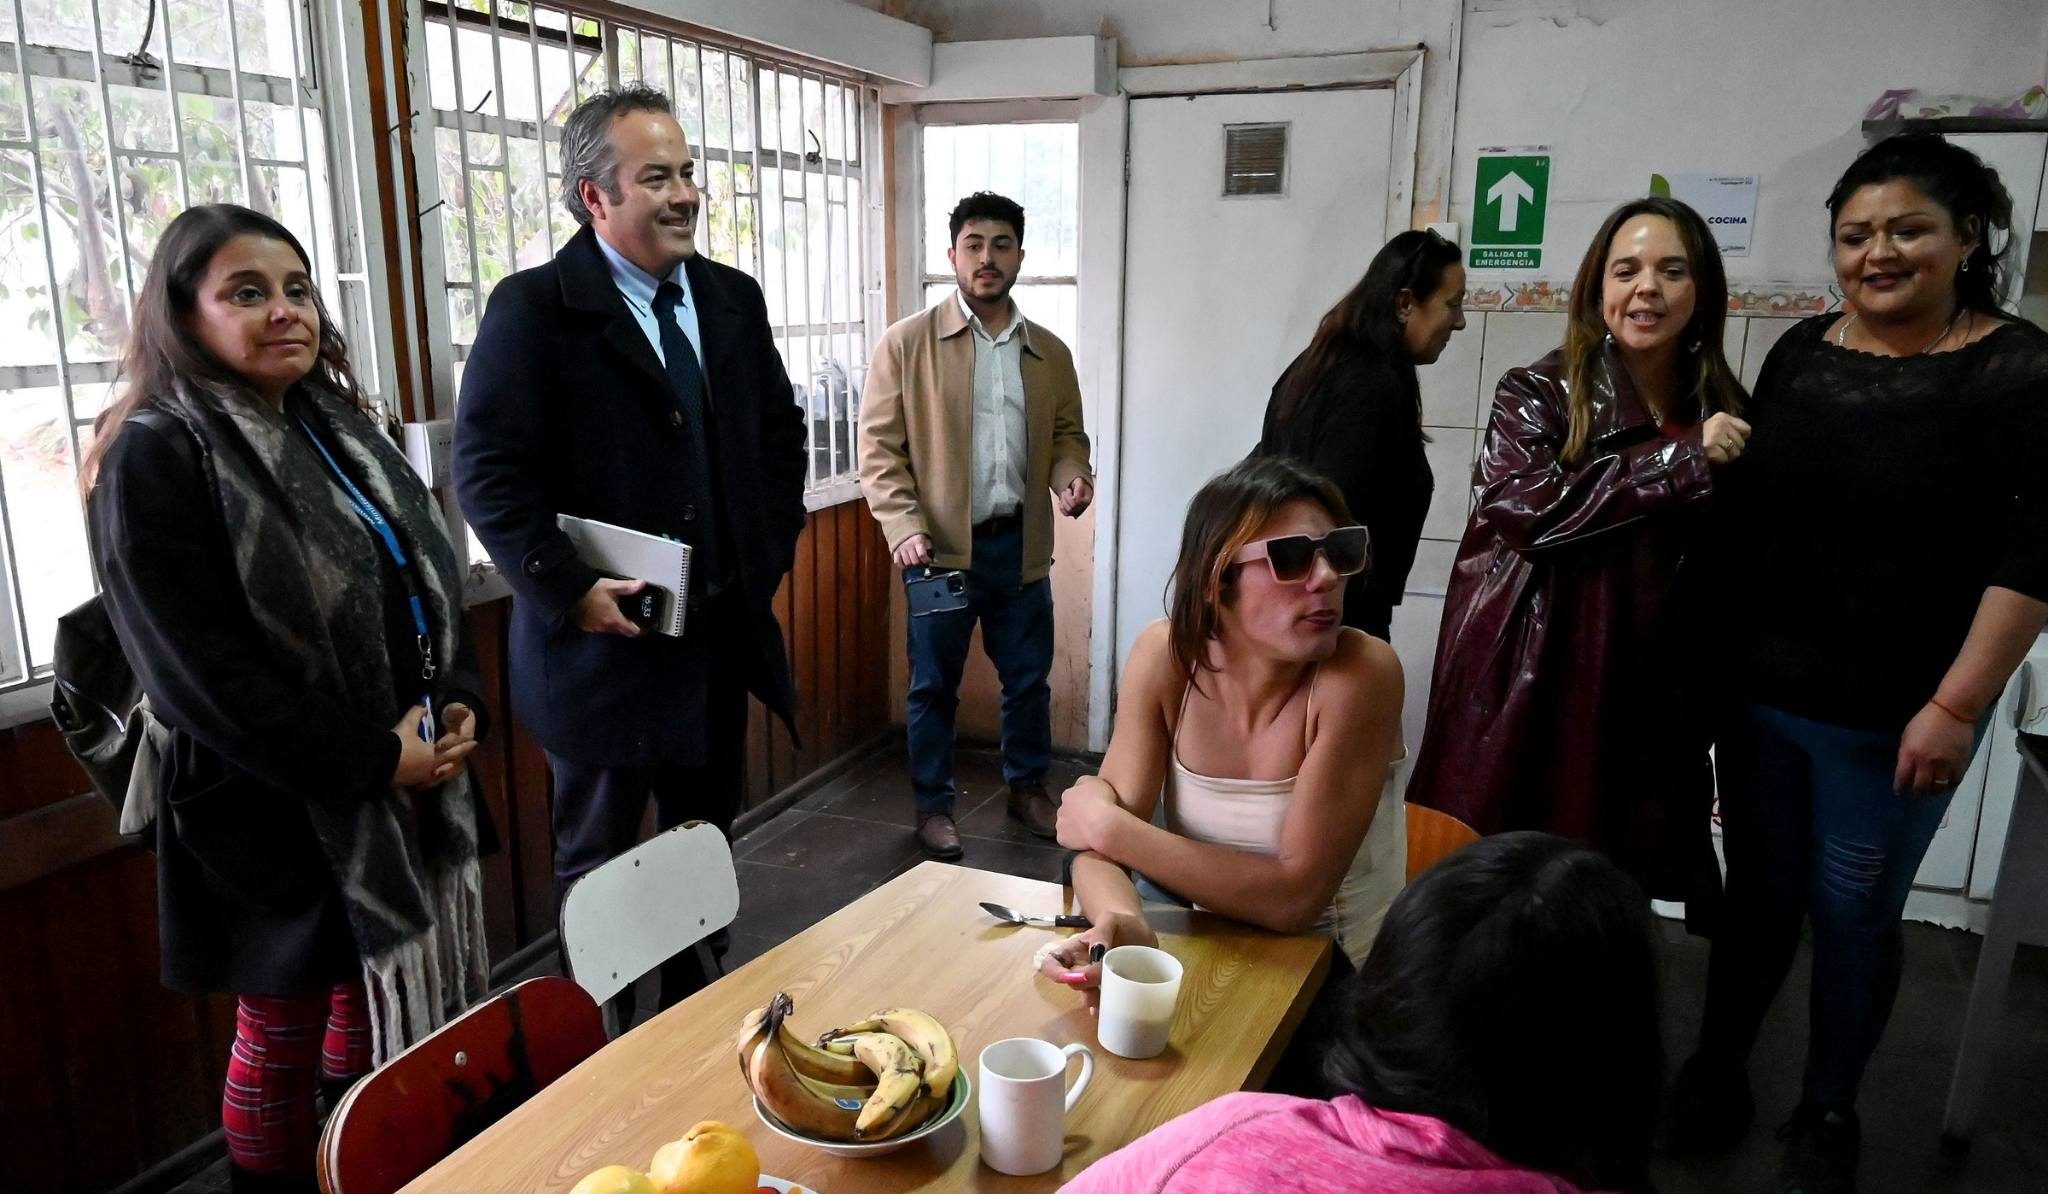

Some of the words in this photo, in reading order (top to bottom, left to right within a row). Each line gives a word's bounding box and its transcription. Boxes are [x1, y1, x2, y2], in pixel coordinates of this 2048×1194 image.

[1708, 216, 1747, 224] COCINA
[1482, 250, 1514, 258] SALIDA
[1516, 250, 1529, 258] DE
